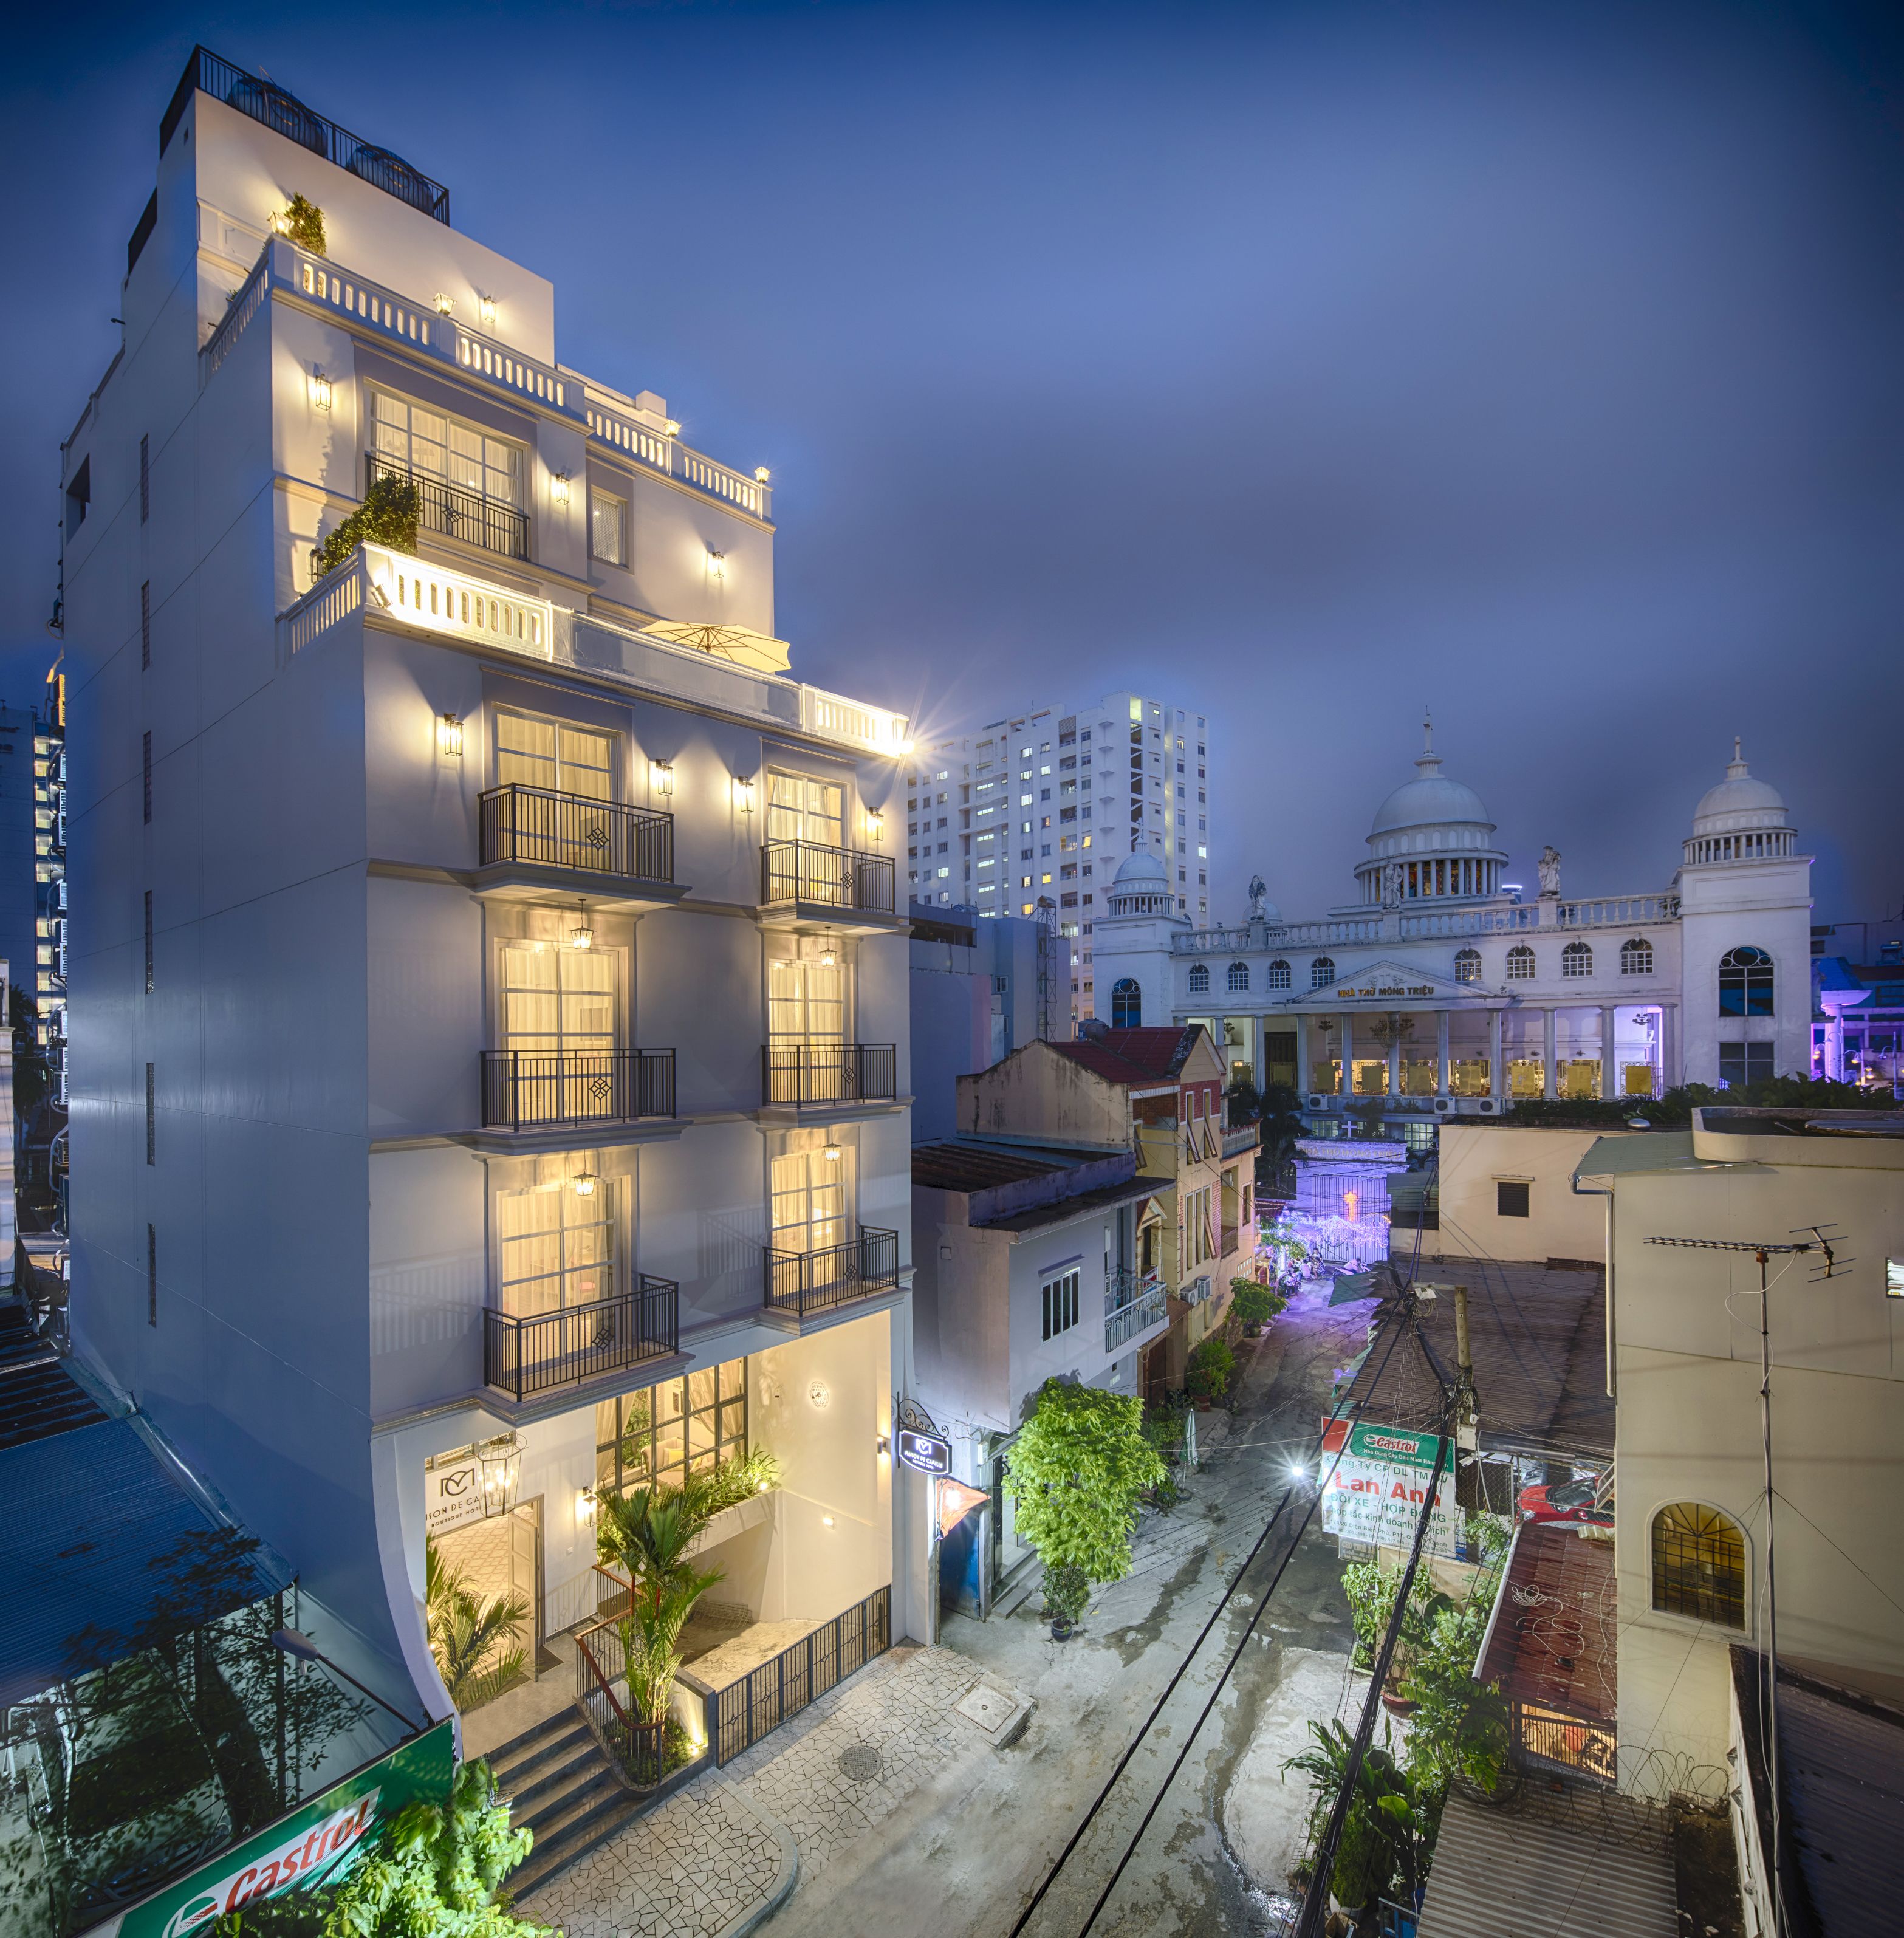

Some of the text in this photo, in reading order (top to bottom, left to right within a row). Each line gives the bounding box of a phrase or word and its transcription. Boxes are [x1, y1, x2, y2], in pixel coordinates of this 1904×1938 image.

[1338, 985, 1434, 998] NHÀ THỜ MÔNG TRIỆU
[1377, 1437, 1417, 1453] Castrol
[1327, 1456, 1355, 1468] Cng
[1358, 1460, 1371, 1471] Ty
[1374, 1463, 1389, 1473] CP
[1393, 1467, 1408, 1476] DL
[1411, 1470, 1428, 1480] TM
[1335, 1471, 1380, 1495] Lan
[451, 1501, 462, 1512] DE
[1331, 1493, 1351, 1505] ĐỘI
[1354, 1497, 1369, 1507] XE
[1381, 1502, 1406, 1515] HỢP
[1410, 1508, 1446, 1523] ĐNG
[431, 1513, 462, 1527] BOUTIQUE
[1349, 1509, 1363, 1519] tác
[1365, 1512, 1383, 1523] kinh
[1386, 1517, 1413, 1530] doanh
[225, 1798, 369, 1914] Castrol
